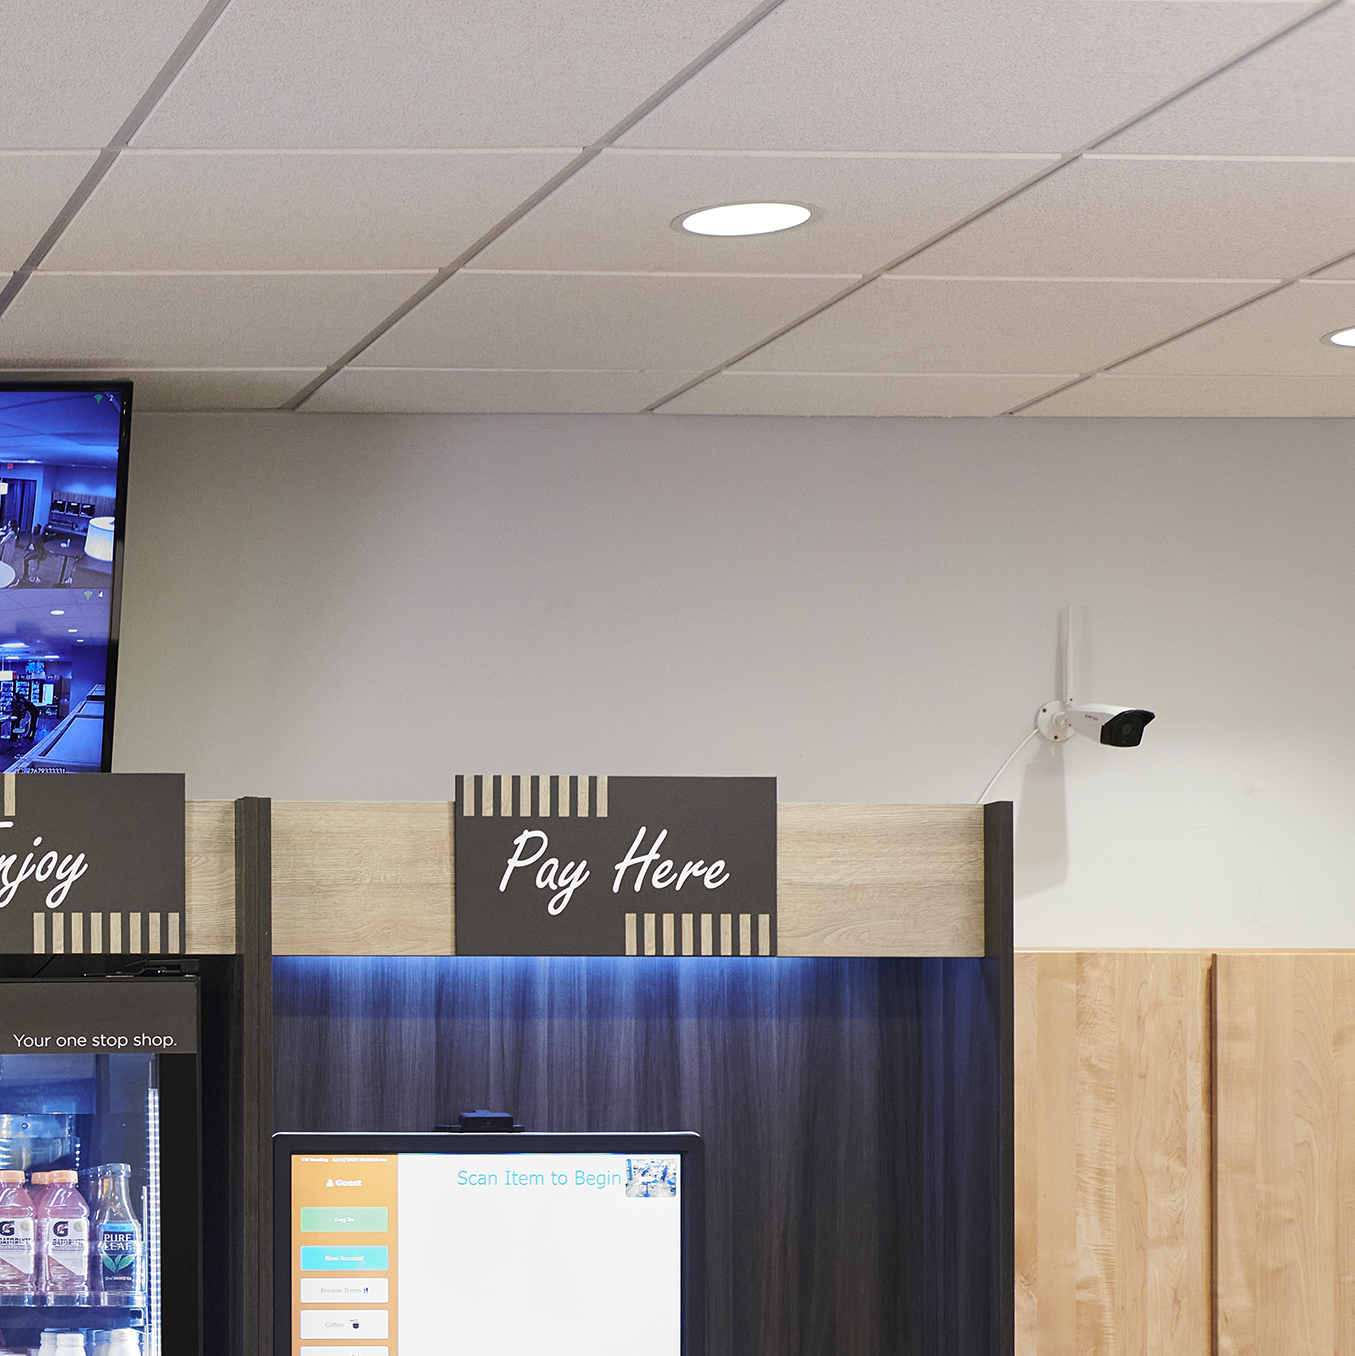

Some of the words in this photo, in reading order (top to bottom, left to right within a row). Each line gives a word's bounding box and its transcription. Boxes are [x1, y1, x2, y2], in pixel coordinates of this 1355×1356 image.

[499, 829, 590, 916] Pay
[612, 826, 731, 893] Here
[13, 1034, 51, 1048] Your
[56, 1036, 87, 1047] one
[92, 1035, 128, 1049] stop
[133, 1033, 177, 1049] shop.
[336, 1179, 362, 1187] Guest
[457, 1170, 498, 1186] Scan
[505, 1170, 545, 1186] Item
[551, 1172, 568, 1186] to
[575, 1170, 622, 1190] Begin
[104, 1234, 131, 1243] PURE
